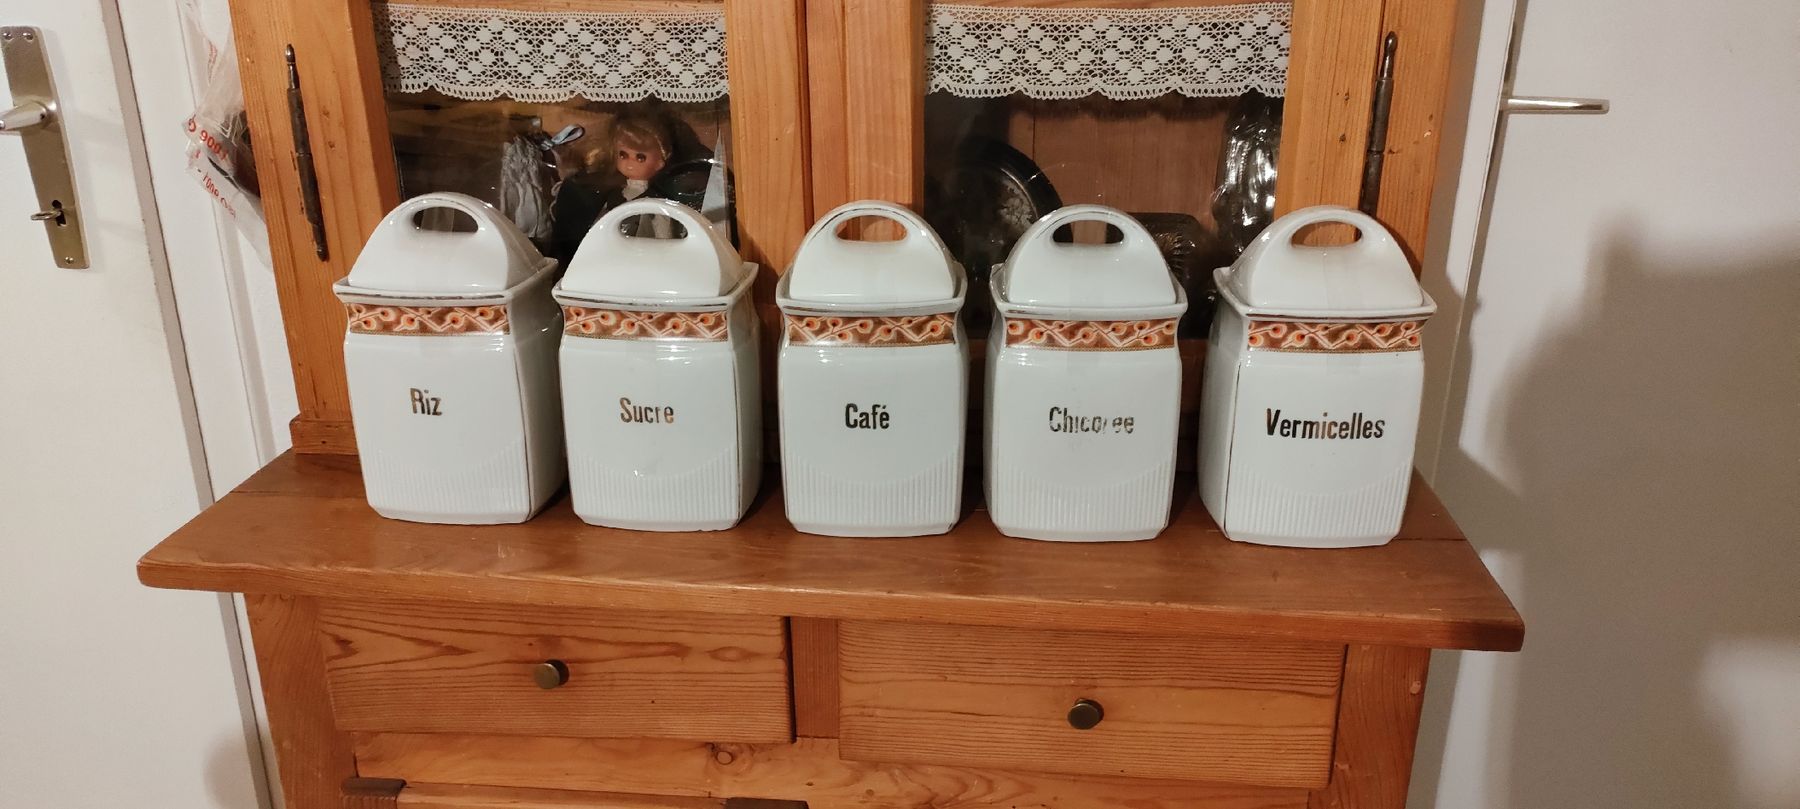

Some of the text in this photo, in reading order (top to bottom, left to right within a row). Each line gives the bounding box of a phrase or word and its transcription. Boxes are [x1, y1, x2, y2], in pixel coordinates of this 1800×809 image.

[409, 387, 443, 416] Riz
[619, 397, 674, 424] Sucre
[845, 403, 890, 430] Café
[1266, 407, 1385, 439] Vermicelles
